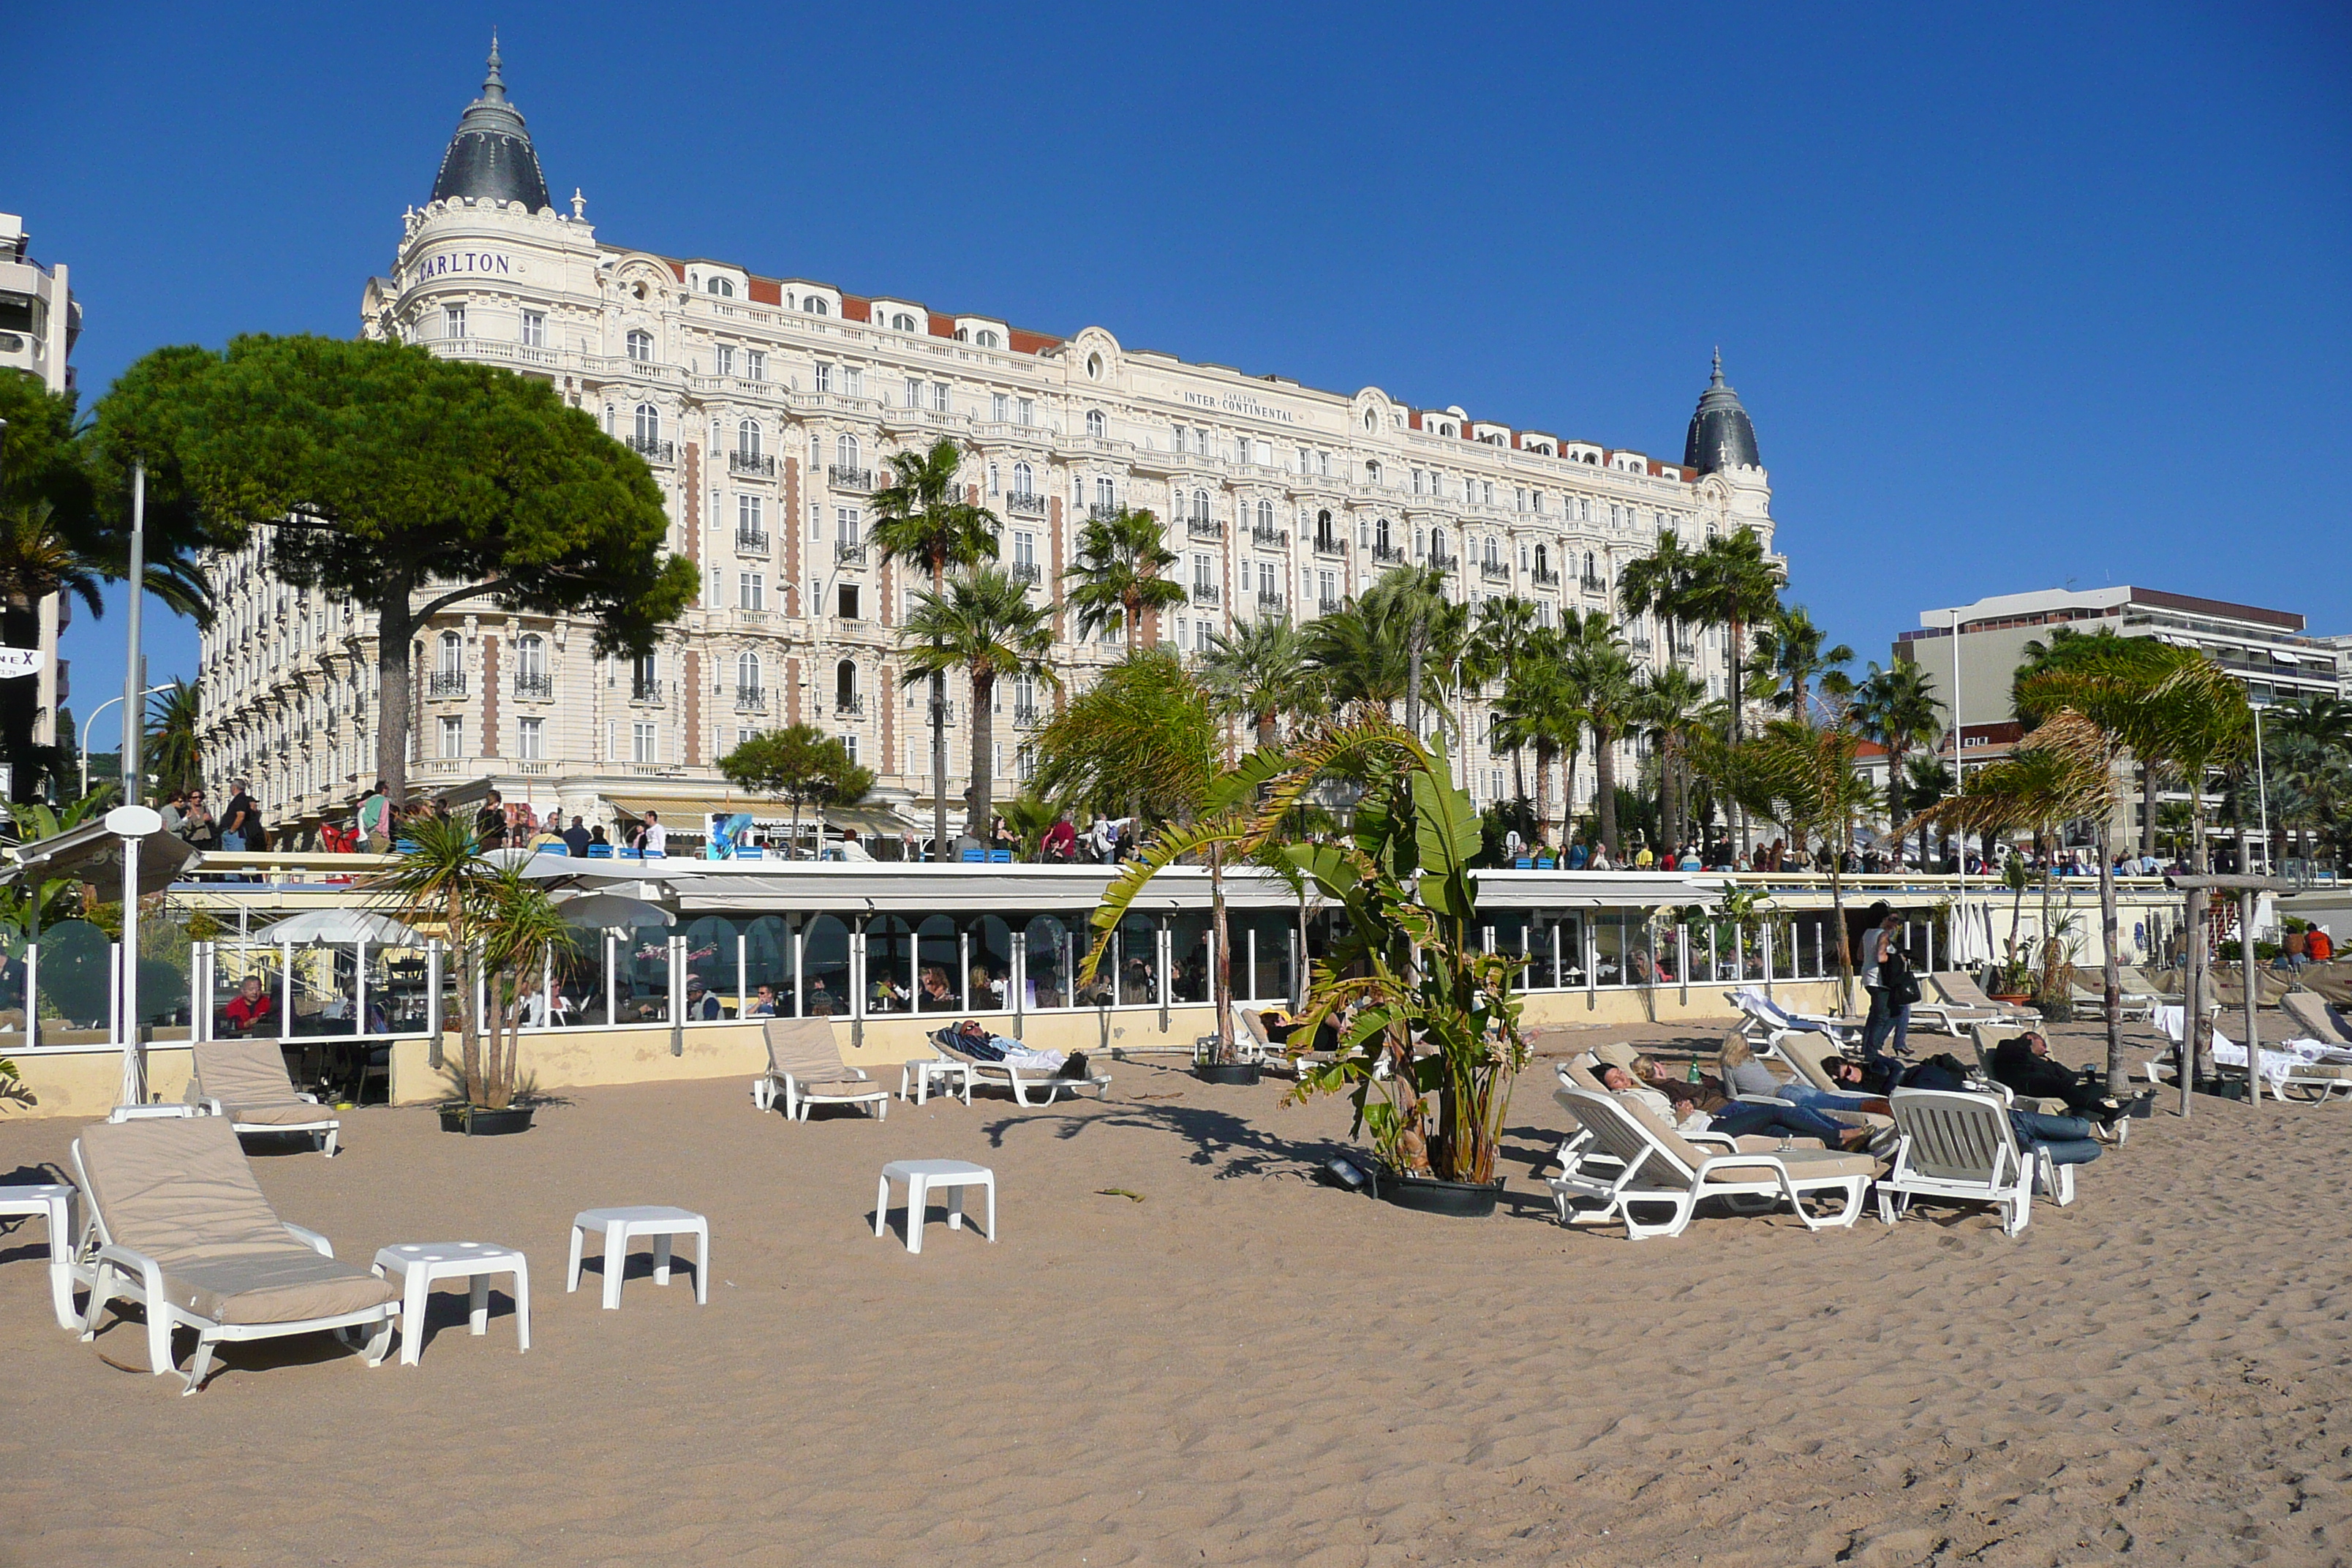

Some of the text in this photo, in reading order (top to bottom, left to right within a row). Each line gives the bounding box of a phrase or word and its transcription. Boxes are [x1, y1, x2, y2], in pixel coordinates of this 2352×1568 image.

[420, 253, 510, 282] CARLTON
[1184, 391, 1294, 423] INTER CONTINENTAL
